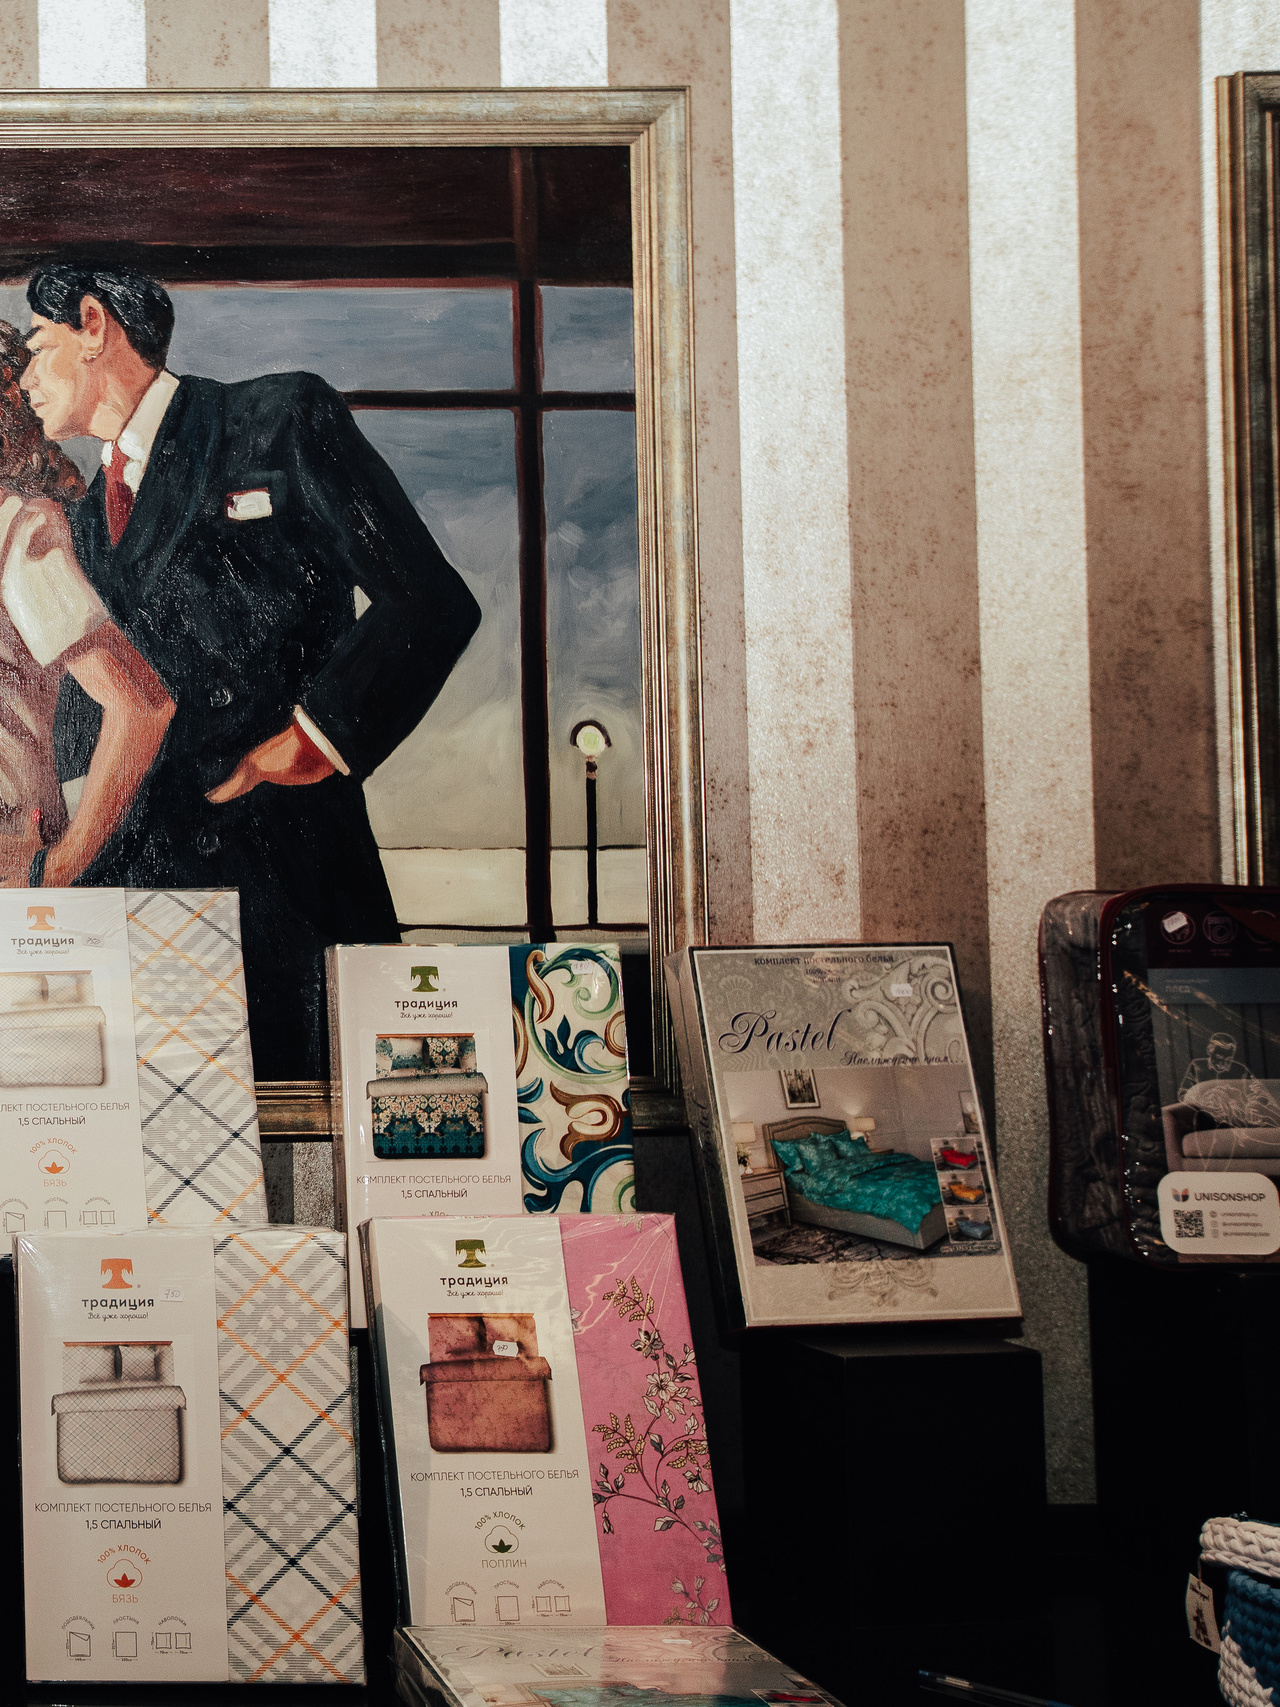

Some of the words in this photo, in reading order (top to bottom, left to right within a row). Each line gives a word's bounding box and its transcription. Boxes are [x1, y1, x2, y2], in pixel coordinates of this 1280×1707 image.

[11, 937, 75, 947] традиция
[44, 948, 70, 956] хорошо!
[394, 1000, 458, 1011] традиция
[412, 1013, 427, 1021] уже
[428, 1012, 453, 1020] хорошо!
[718, 1009, 852, 1054] Pastel
[25, 1102, 98, 1112] ПОСТЕЛЬНОГО
[100, 1102, 130, 1111] БЕЛЬЯ
[18, 1117, 30, 1127] 1,5
[31, 1115, 86, 1126] СПАЛЬНЫЙ
[29, 1140, 46, 1155] 100%
[47, 1137, 78, 1154] ХЛОПОК
[43, 1179, 68, 1187] БЯЗЬ
[409, 1175, 480, 1184] ПОСТЕЛЬНОГО
[482, 1175, 512, 1184] БЕЛЬЯ
[401, 1189, 413, 1200] 1,5
[414, 1188, 468, 1198] СПАЛЬНЫЙ
[1194, 1192, 1265, 1201] UNISONSHOP
[440, 1277, 508, 1288] традиция
[460, 1291, 475, 1299] уже
[477, 1289, 504, 1298] хорошо!
[81, 1299, 154, 1311] традиция
[102, 1313, 118, 1322] уже
[119, 1312, 149, 1321] хорошо!
[410, 1471, 465, 1482] КОМПЛЕКТ
[467, 1470, 545, 1480] ПОСТЕЛЬНОГО
[547, 1469, 580, 1479] БЕЛЬЯ
[460, 1487, 473, 1498] 1,5
[474, 1485, 533, 1497] СПАЛЬНЫЙ
[34, 1502, 92, 1513] КОМПЛЕКТ
[94, 1502, 176, 1513] ПОСТЕЛЬНОГО
[178, 1502, 212, 1513] БЕЛЬЯ
[85, 1519, 98, 1531] 1,5
[100, 1518, 162, 1529] СПАЛЬНЫЙ
[474, 1514, 492, 1530] 100%
[492, 1511, 526, 1530] ХЛОПОК
[97, 1547, 116, 1564] 100%
[117, 1544, 151, 1565] ХЛОПОК
[481, 1559, 527, 1569] ПОПЛИН
[112, 1594, 139, 1604] БЯЗЬ
